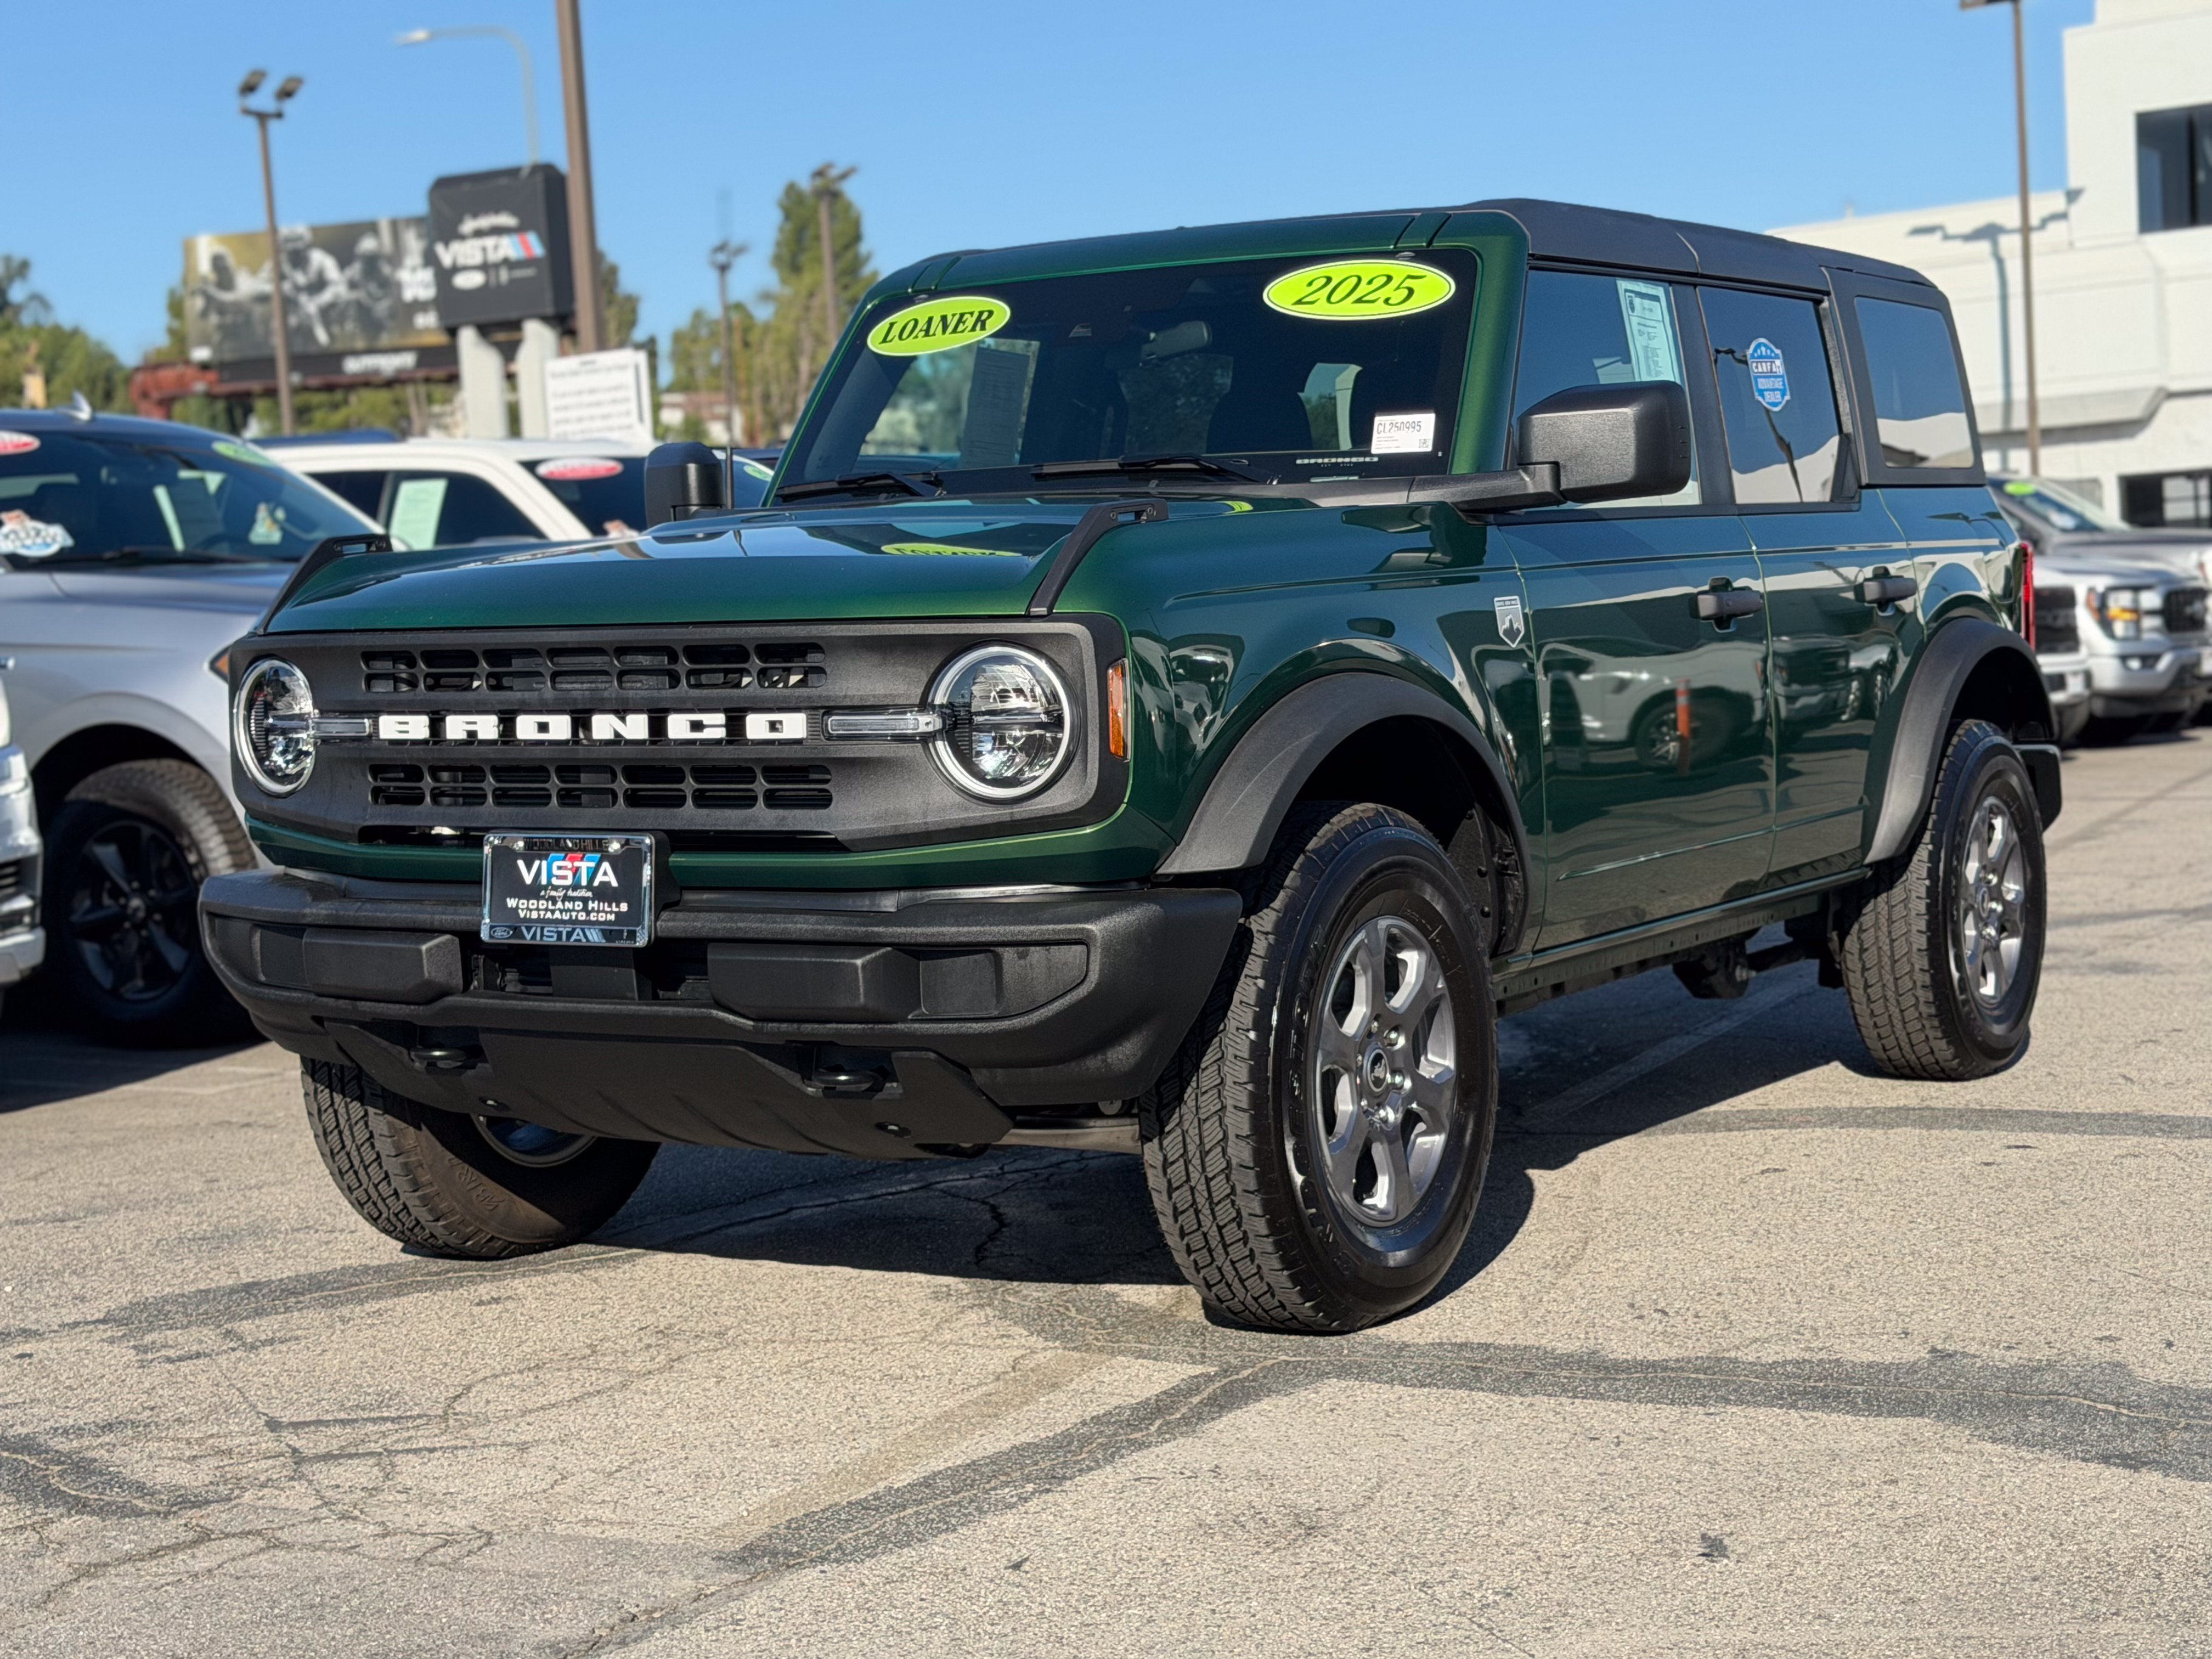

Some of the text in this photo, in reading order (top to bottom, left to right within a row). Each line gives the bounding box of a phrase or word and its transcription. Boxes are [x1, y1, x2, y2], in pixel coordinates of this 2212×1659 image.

[434, 234, 518, 269] VISTA
[1291, 274, 1427, 306] 2025
[878, 309, 994, 345] LOANER
[1376, 421, 1422, 435] CL250995
[379, 713, 808, 740] BRONCO
[517, 860, 619, 887] VISTA
[545, 885, 566, 901] family
[521, 926, 586, 943] VISTA
